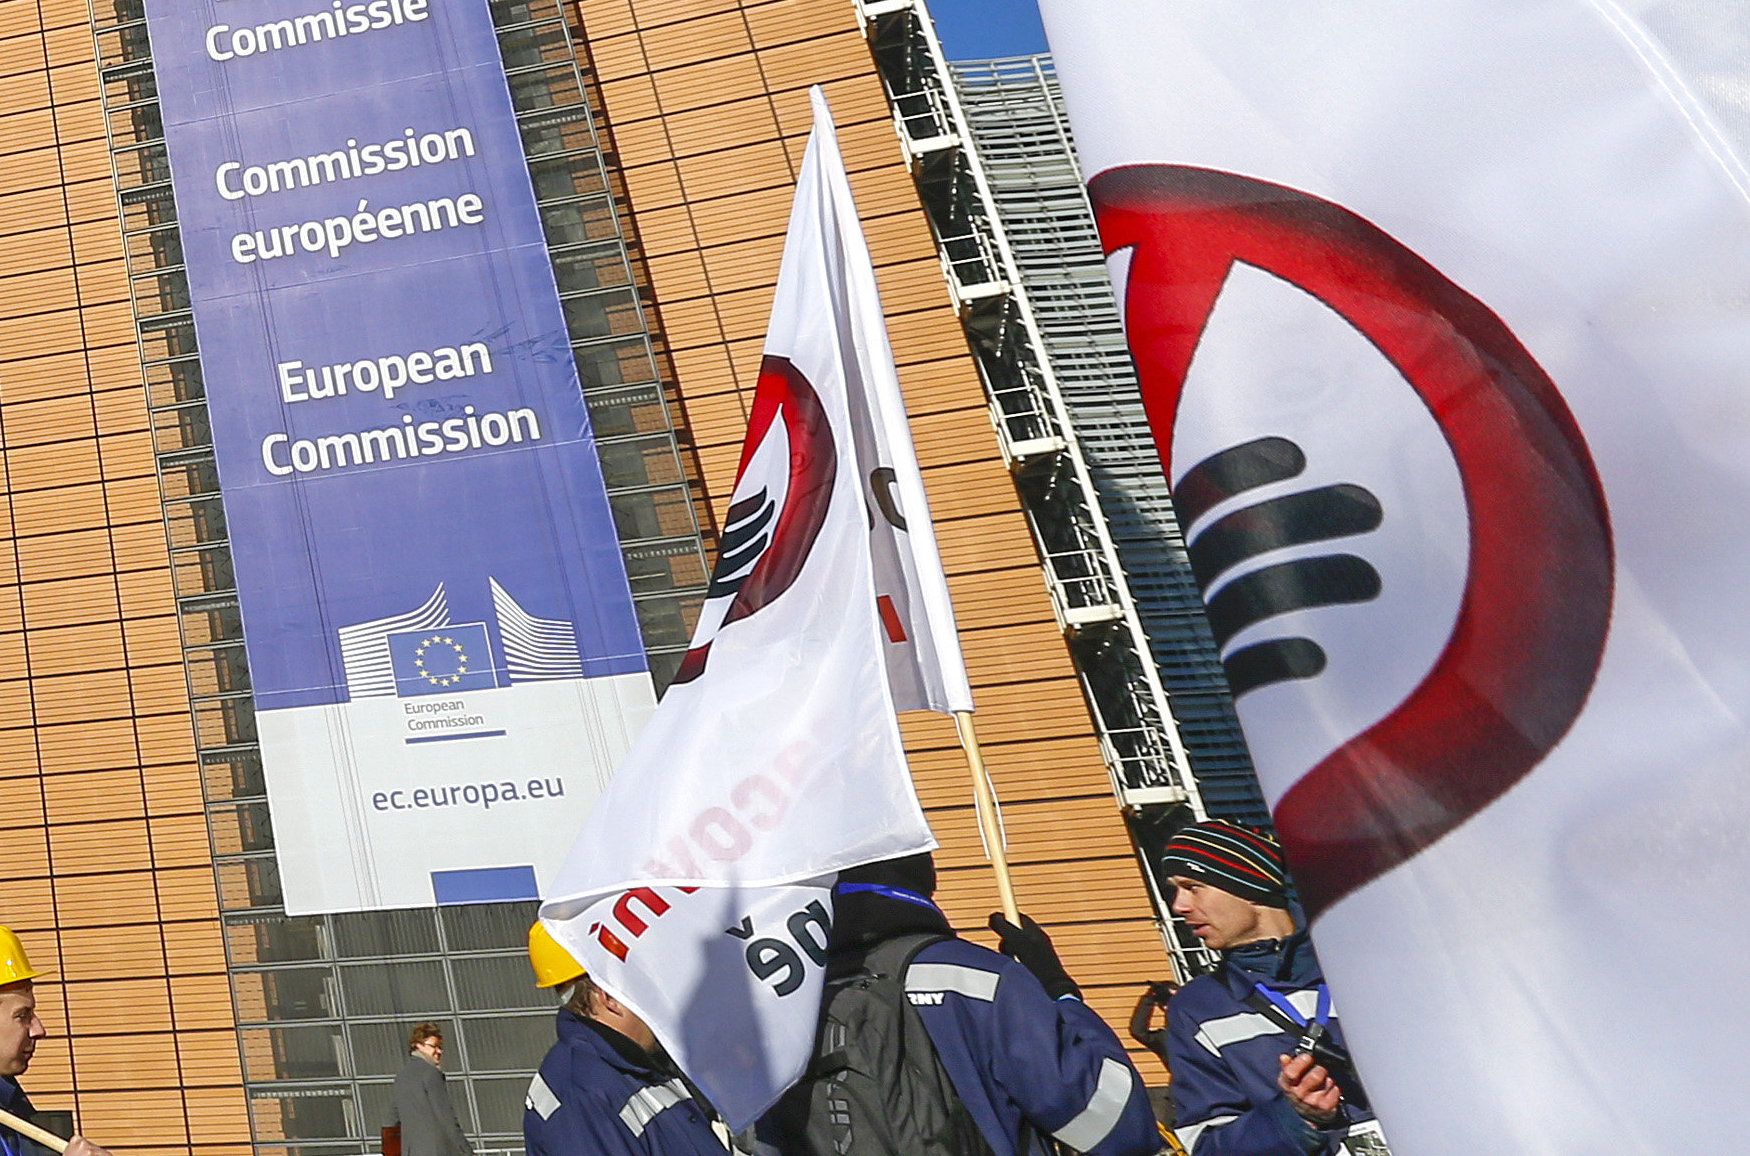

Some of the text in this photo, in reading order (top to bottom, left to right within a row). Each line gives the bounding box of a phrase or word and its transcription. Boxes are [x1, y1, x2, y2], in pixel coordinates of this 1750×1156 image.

[214, 125, 476, 201] Commission
[231, 191, 485, 265] européenne
[277, 341, 493, 404] European
[261, 405, 542, 477] Commission
[404, 699, 465, 715] European
[408, 714, 484, 731] Commission
[372, 775, 565, 811] ec.europa.eu
